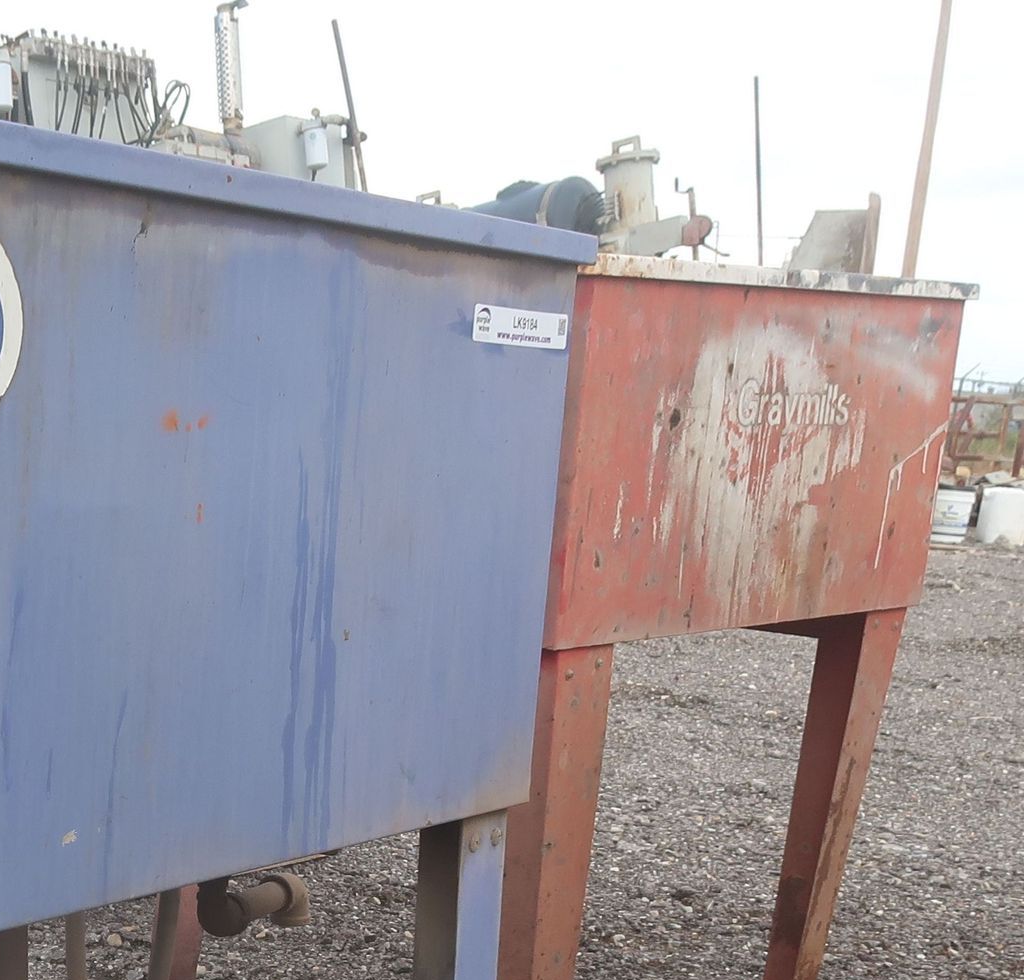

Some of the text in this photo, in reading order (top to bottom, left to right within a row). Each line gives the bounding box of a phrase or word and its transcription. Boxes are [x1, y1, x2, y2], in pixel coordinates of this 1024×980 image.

[512, 315, 538, 331] LK9184
[496, 331, 552, 344] www.purplewave.com
[737, 377, 851, 436] Graymills
